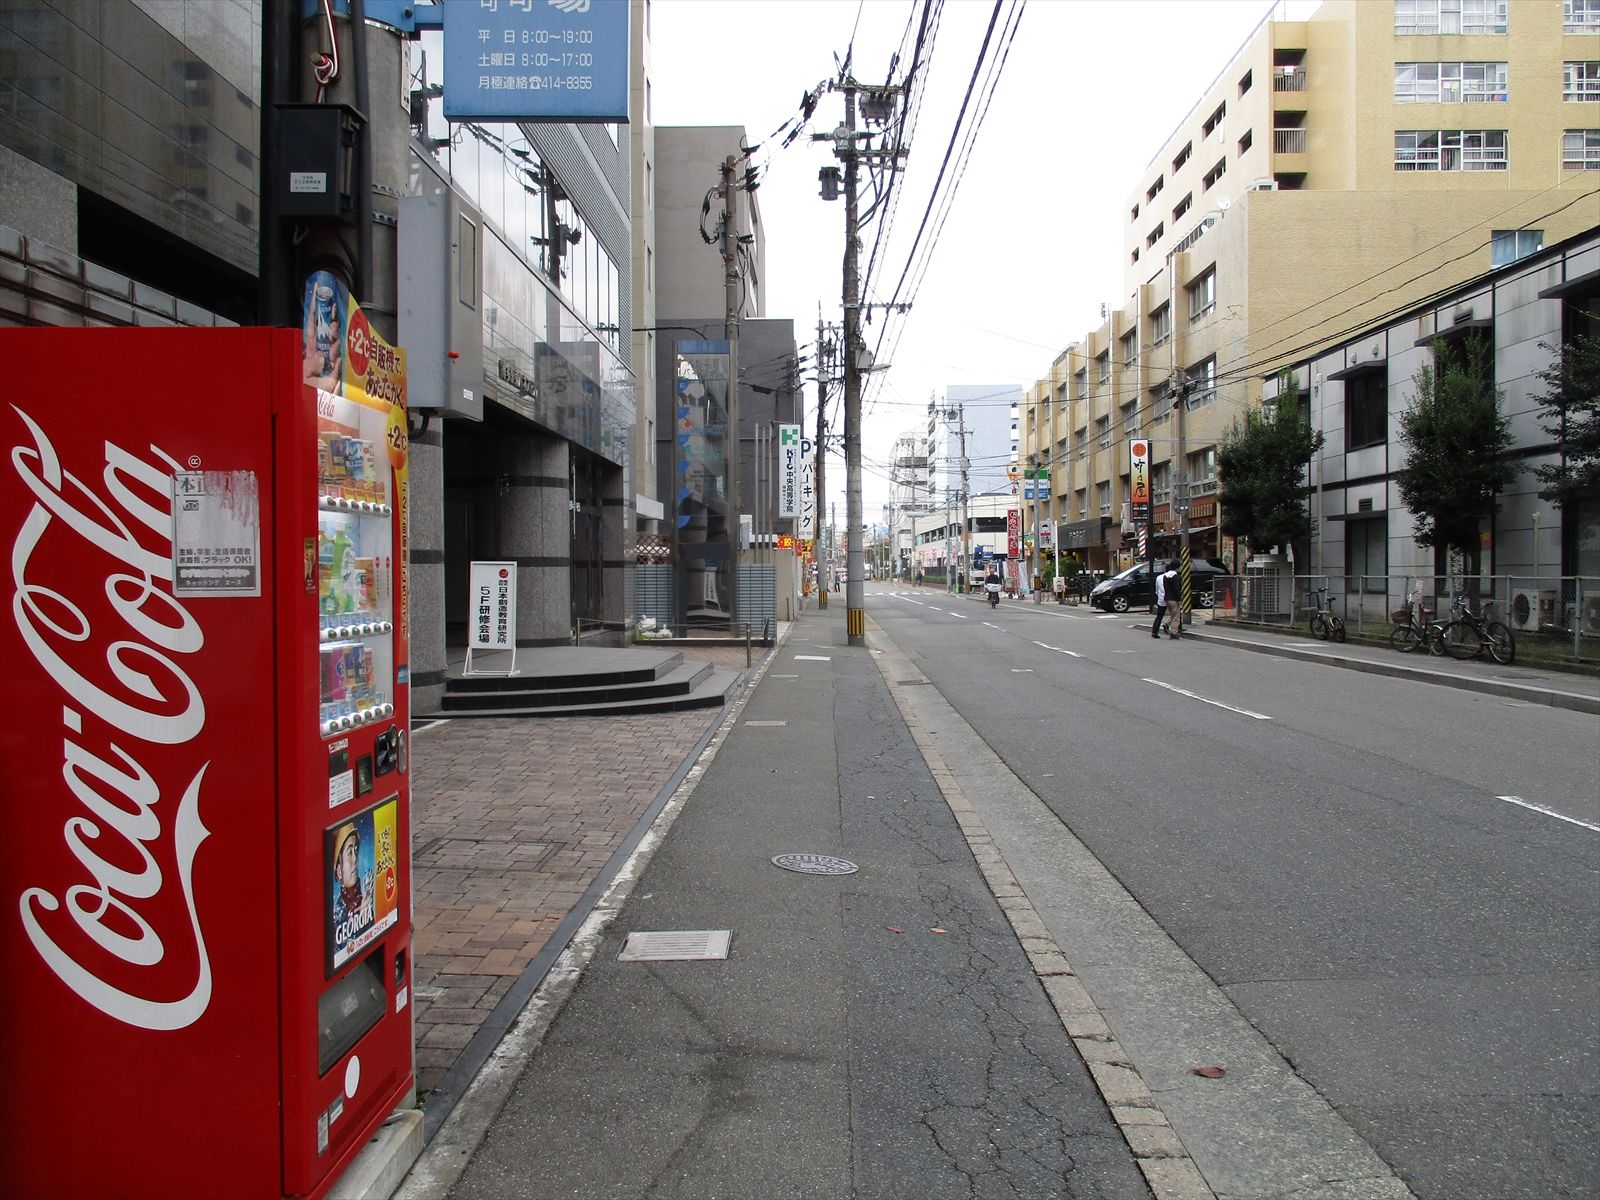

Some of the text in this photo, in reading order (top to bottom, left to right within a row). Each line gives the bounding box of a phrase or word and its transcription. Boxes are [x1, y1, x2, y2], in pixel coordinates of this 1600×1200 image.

[478, 53, 515, 67] 土曜日
[478, 586, 491, 644] 5F研修会場
[10, 402, 212, 1030] Coca-Cola
[335, 904, 374, 945] GEORGIA
